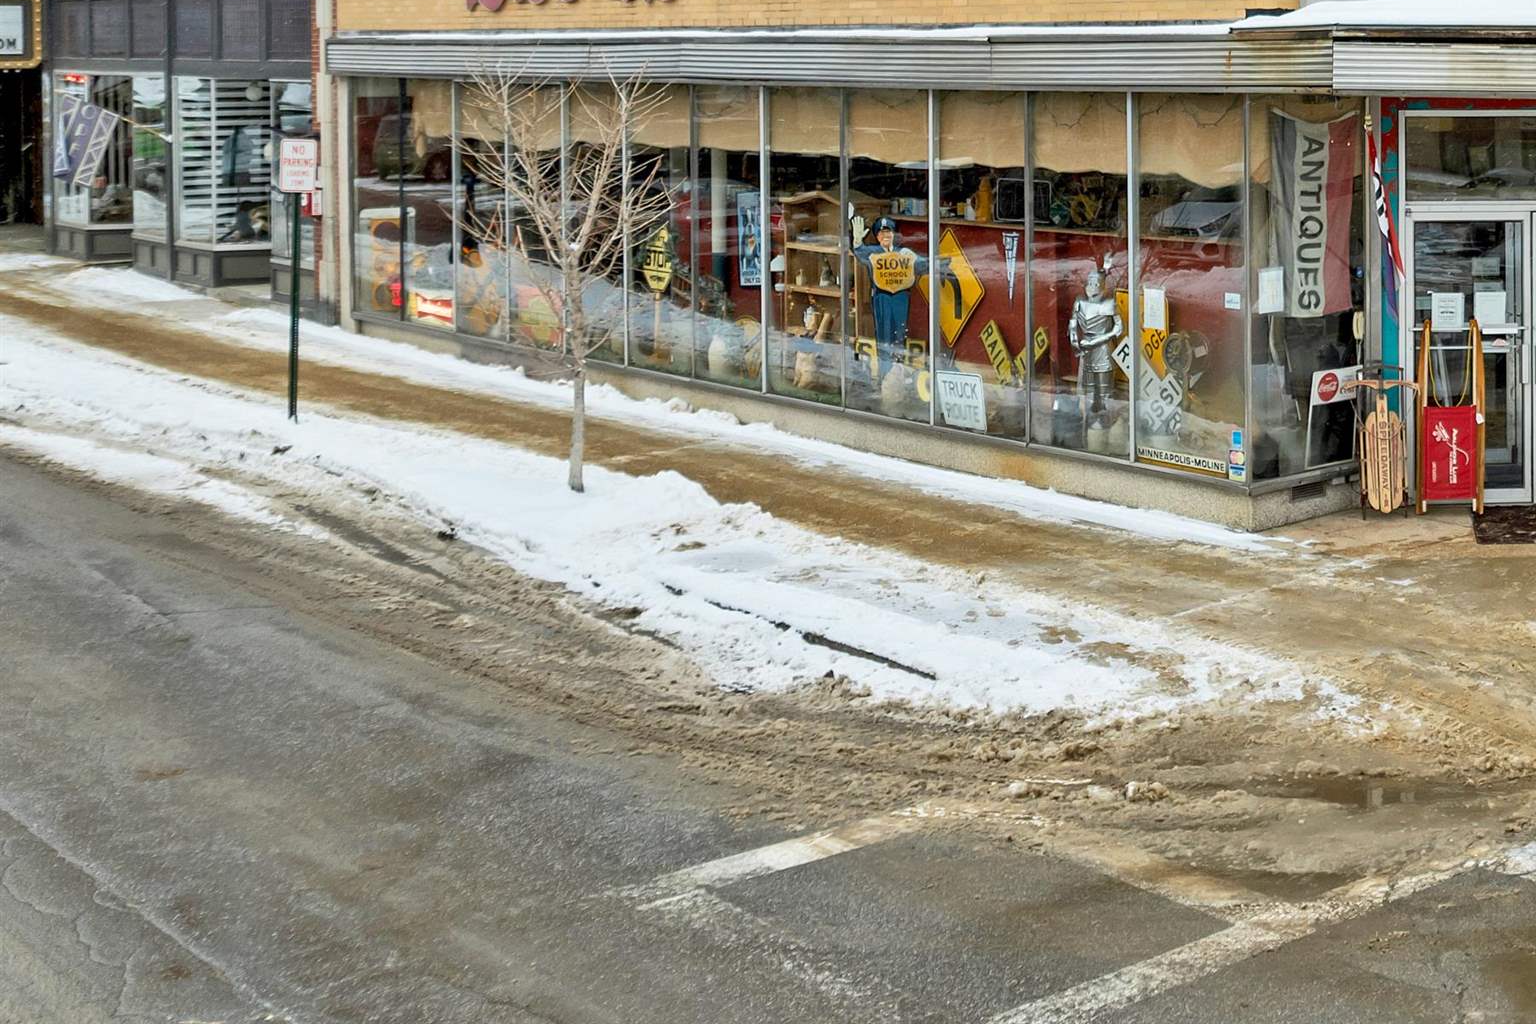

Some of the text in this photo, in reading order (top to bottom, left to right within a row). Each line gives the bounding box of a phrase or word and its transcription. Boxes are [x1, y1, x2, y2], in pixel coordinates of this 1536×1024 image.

[291, 145, 305, 155] NO
[282, 158, 315, 168] PARKING
[1296, 135, 1325, 311] ANTIQUES
[876, 257, 910, 270] SLOW
[983, 324, 1005, 376] RAIL
[942, 379, 978, 399] TRUCK
[944, 402, 980, 423] ROUTE
[1137, 447, 1225, 472] MINNEAPOLIS-MOLINE
[1379, 421, 1389, 490] SPEEDAWAY
